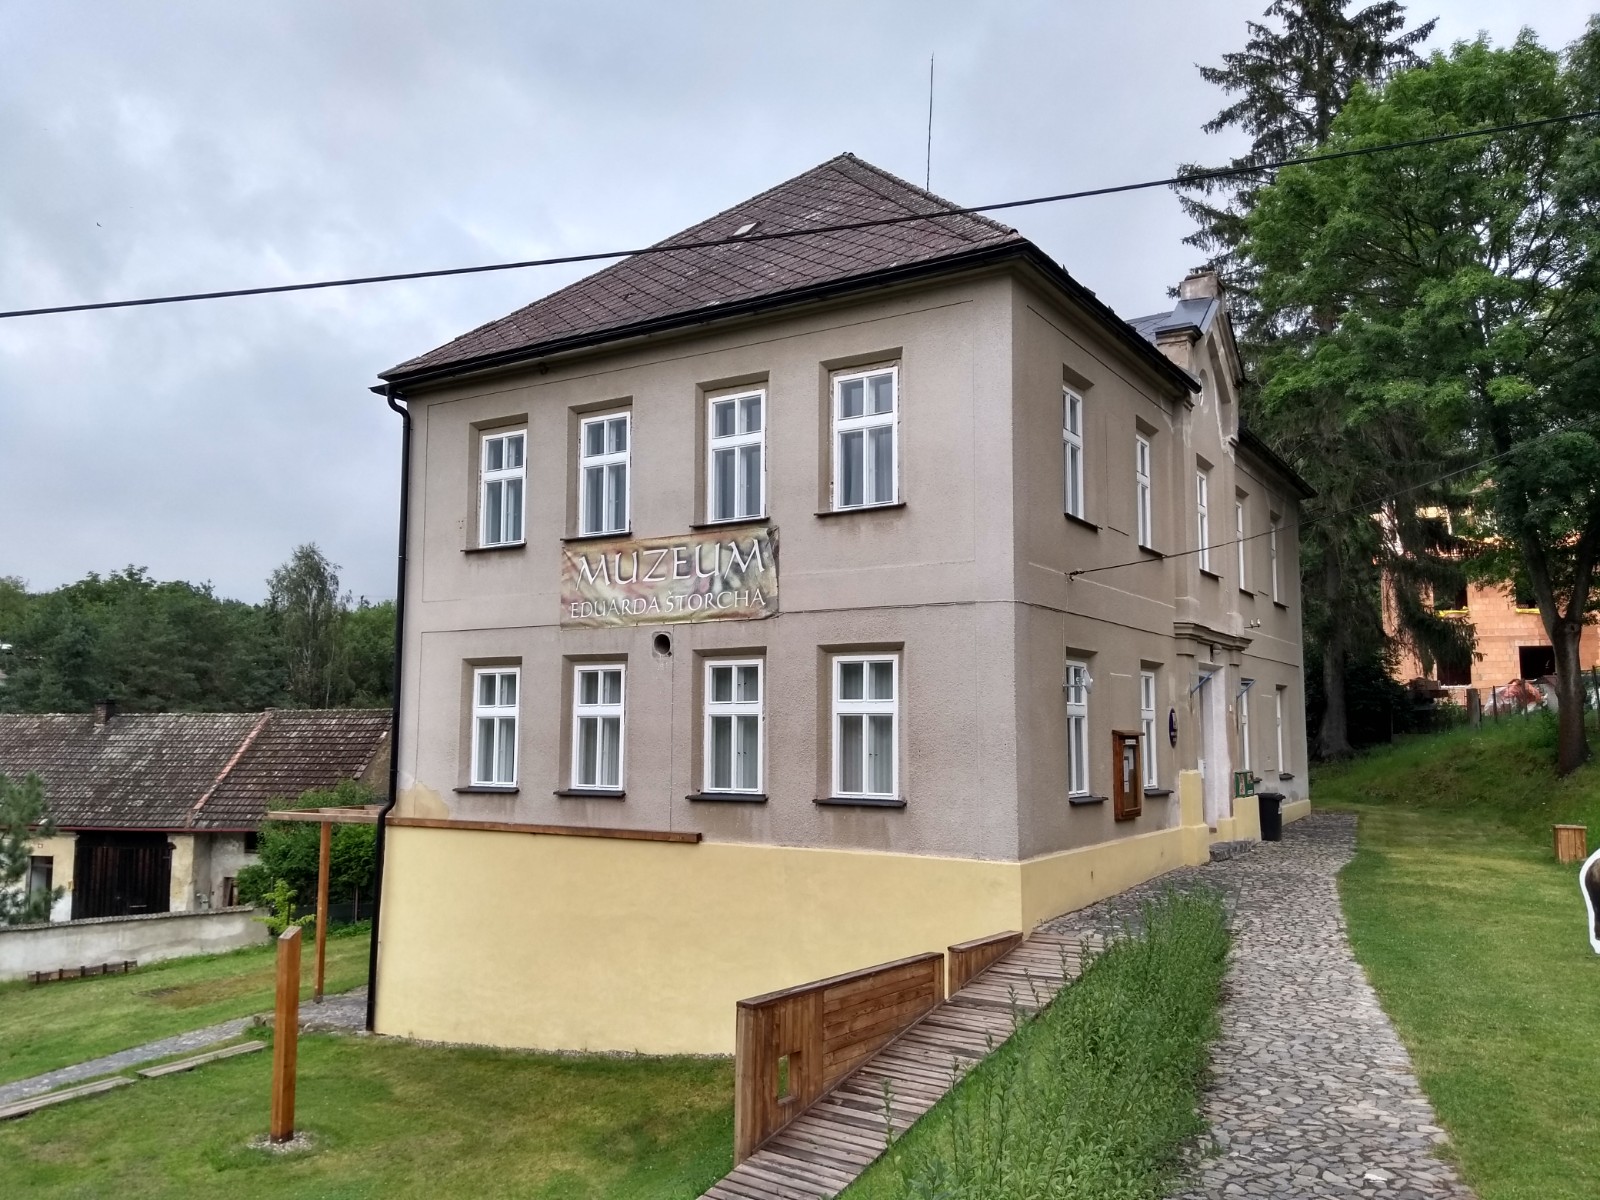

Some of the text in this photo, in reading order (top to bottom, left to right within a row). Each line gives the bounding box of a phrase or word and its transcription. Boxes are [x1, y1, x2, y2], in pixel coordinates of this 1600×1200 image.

[576, 539, 766, 591] MUZEUM
[570, 588, 766, 618] EDUARDA ŠTORCHA
